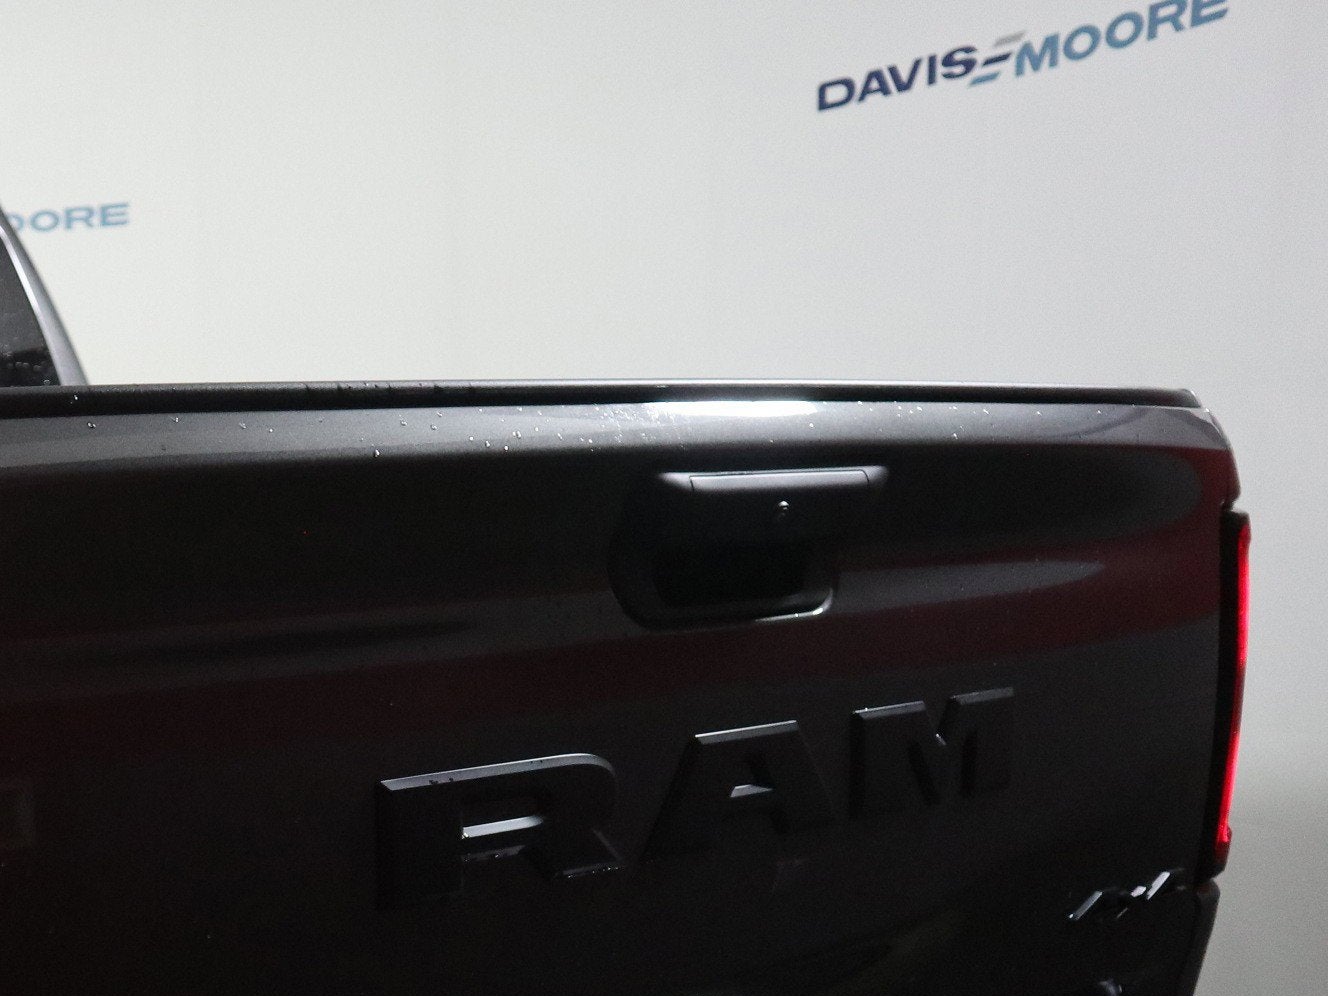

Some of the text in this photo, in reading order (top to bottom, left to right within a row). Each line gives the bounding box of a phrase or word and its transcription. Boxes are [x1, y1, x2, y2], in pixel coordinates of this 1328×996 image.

[816, 0, 1230, 112] DAVIS MOORE
[374, 686, 1015, 912] RAM
